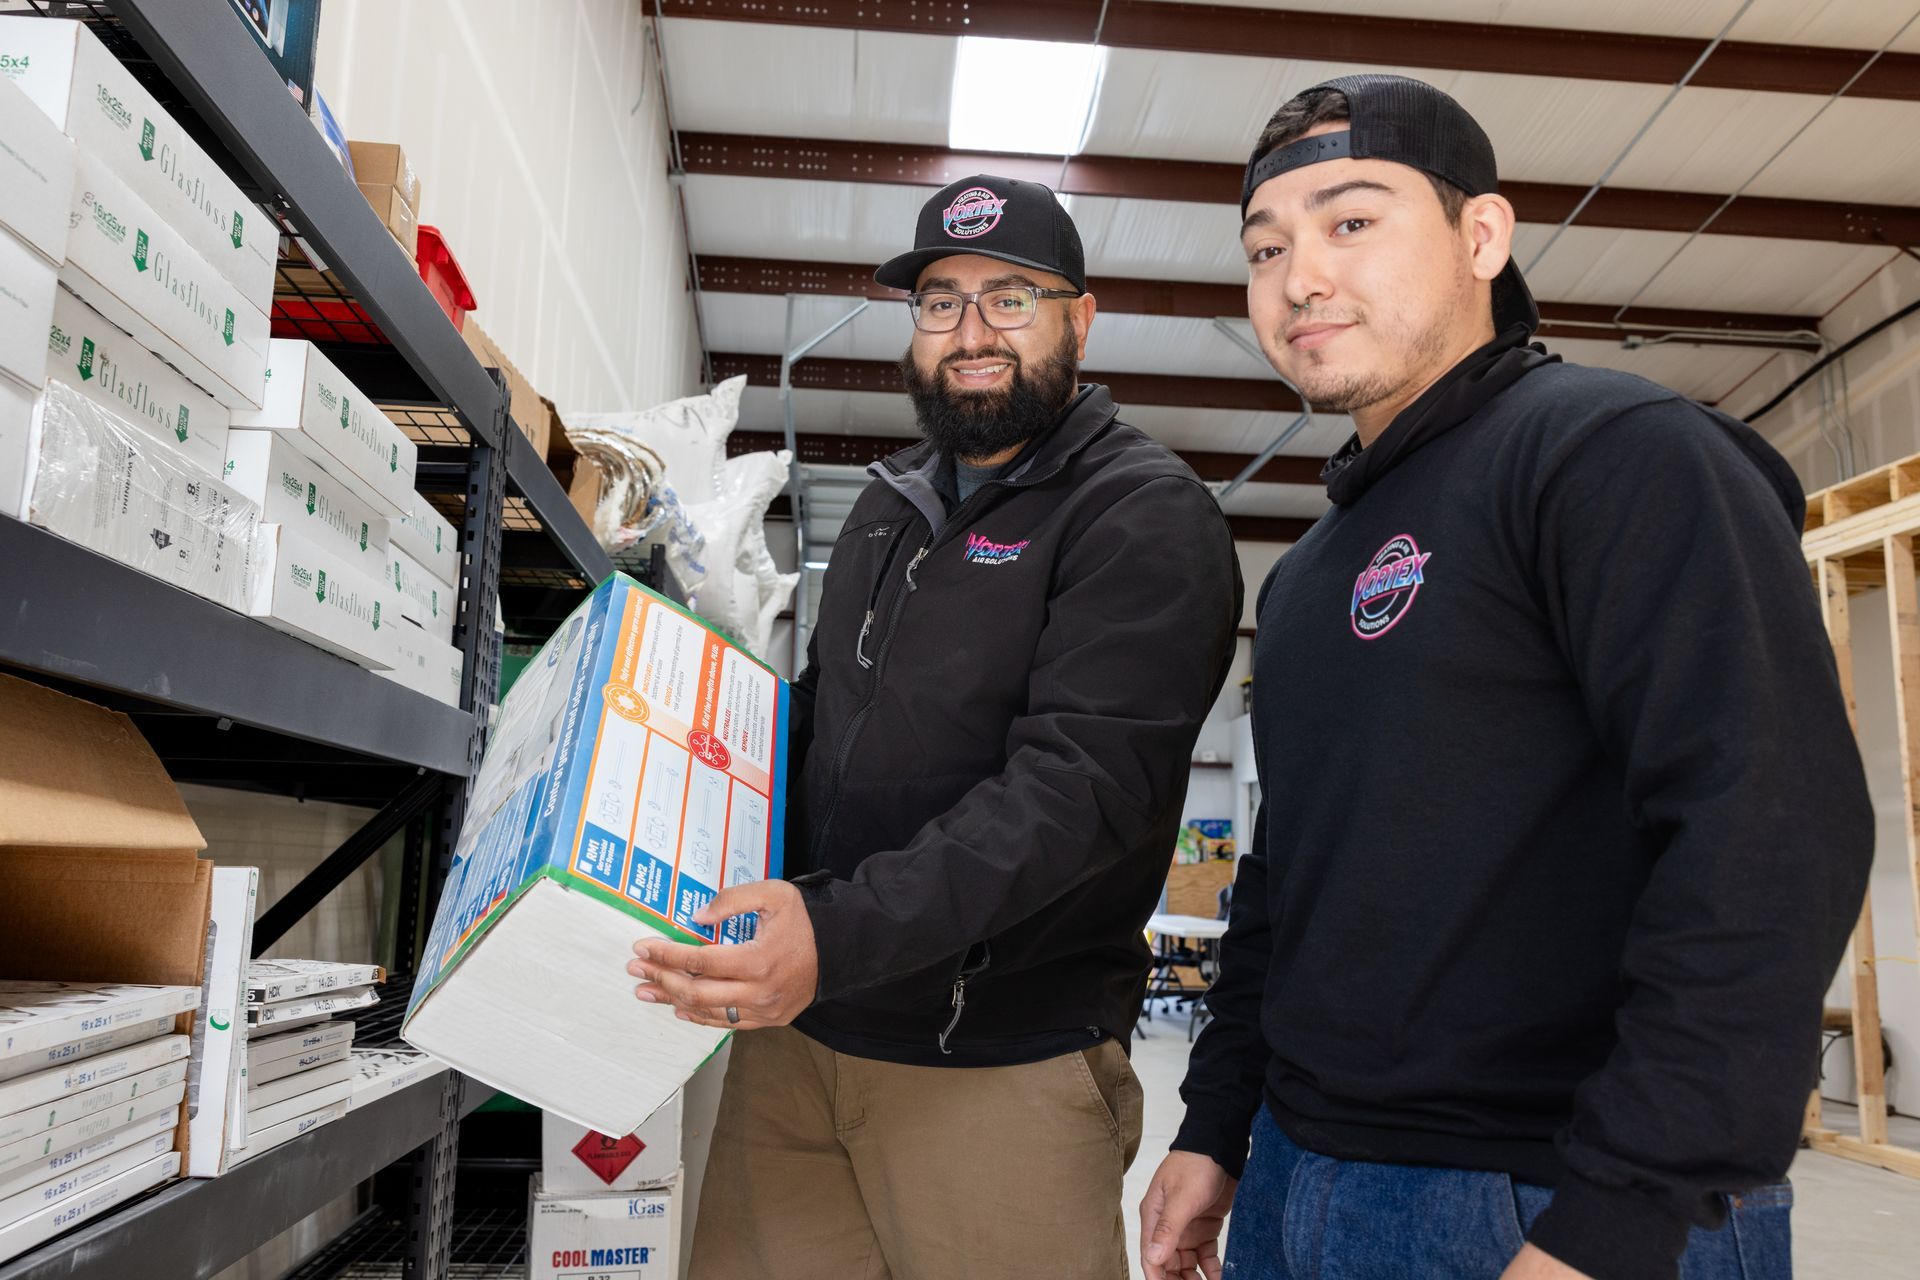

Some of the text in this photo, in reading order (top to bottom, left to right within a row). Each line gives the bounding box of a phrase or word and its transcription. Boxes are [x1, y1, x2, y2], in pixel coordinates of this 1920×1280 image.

[97, 84, 132, 125] 16x25x4
[160, 143, 228, 232] Glasfloss
[92, 201, 127, 238] 16x25x4
[943, 199, 1008, 230] VORTEX
[954, 222, 989, 235] SOLUTIONS
[154, 251, 219, 331] Glasfloss
[99, 364, 171, 430] Glasfloss
[351, 409, 390, 461] Glasfloss
[122, 461, 134, 515] WARNING
[187, 483, 195, 496] 8
[318, 494, 359, 543] Glasfloss
[1350, 552, 1432, 616] VORTEX
[328, 579, 371, 623] Glasfloss
[1359, 614, 1390, 630] SOLUTIONS
[625, 631, 637, 657] effective
[711, 642, 719, 661] PLUS:
[705, 677, 715, 703] benefits
[701, 717, 709, 728] All
[703, 700, 711, 713] the
[722, 707, 731, 742] NEUTRALIZE
[544, 769, 563, 817] Control
[558, 729, 573, 769] germs
[568, 707, 578, 730] and
[573, 675, 585, 708] odors
[586, 839, 600, 862] RM1
[596, 839, 609, 871] Germicidal
[604, 842, 615, 876] UVC System
[635, 863, 648, 888] RM2
[644, 858, 657, 904] Dual Germicidal
[652, 867, 662, 901] UVC System
[681, 889, 693, 914] RM2
[268, 986, 281, 998] HDX
[262, 1008, 275, 1021] HDX
[628, 1199, 665, 1216] iGas
